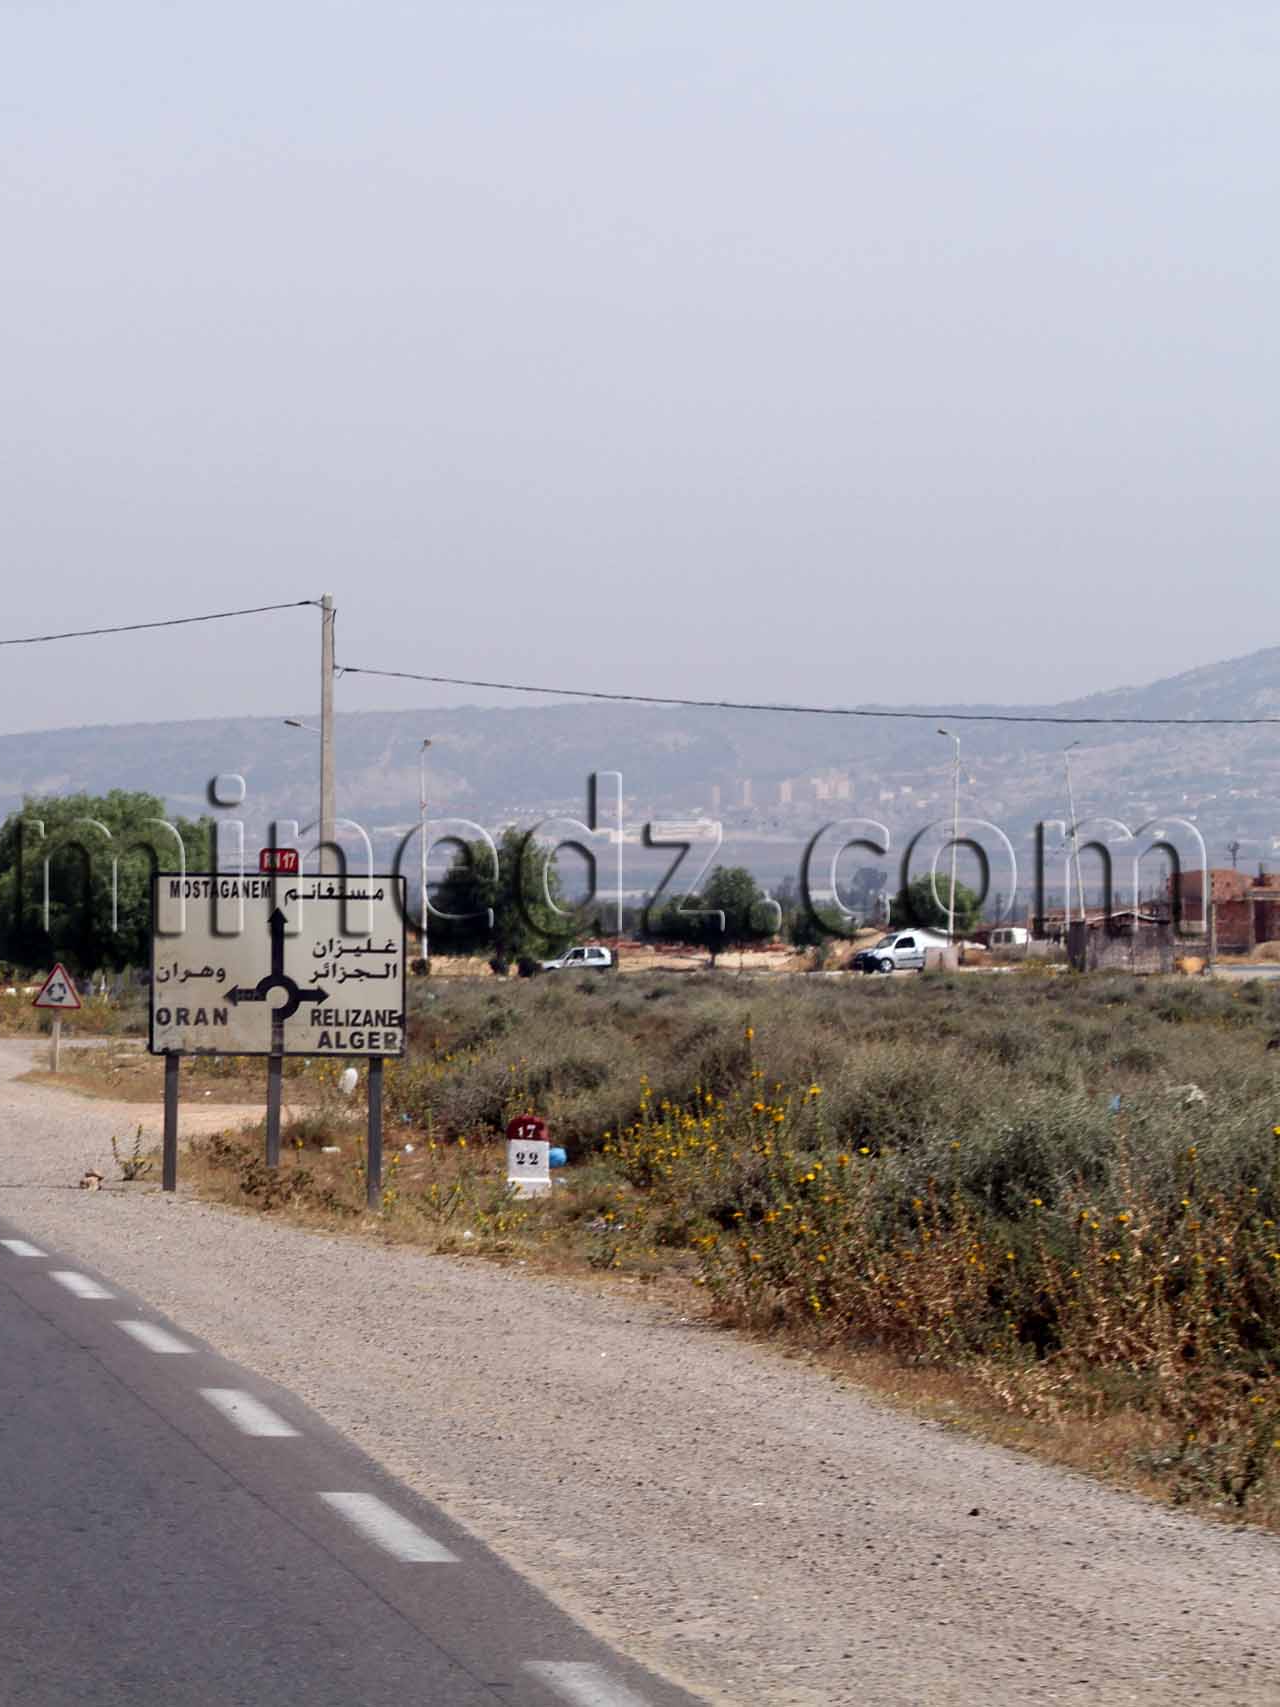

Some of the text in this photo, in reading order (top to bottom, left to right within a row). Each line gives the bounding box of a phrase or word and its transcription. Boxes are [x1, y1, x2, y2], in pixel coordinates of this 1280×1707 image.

[169, 879, 273, 900] MOSTAGANEM
[284, 881, 385, 908] مستغانم
[312, 938, 398, 959] غليزان
[156, 961, 226, 984] وهران
[308, 961, 398, 985] الجزائر
[155, 1007, 228, 1026] ORAN
[310, 1008, 401, 1028] RELIZANE
[317, 1030, 398, 1049] ALGER
[518, 1125, 536, 1138] 17
[516, 1152, 538, 1165] 22
